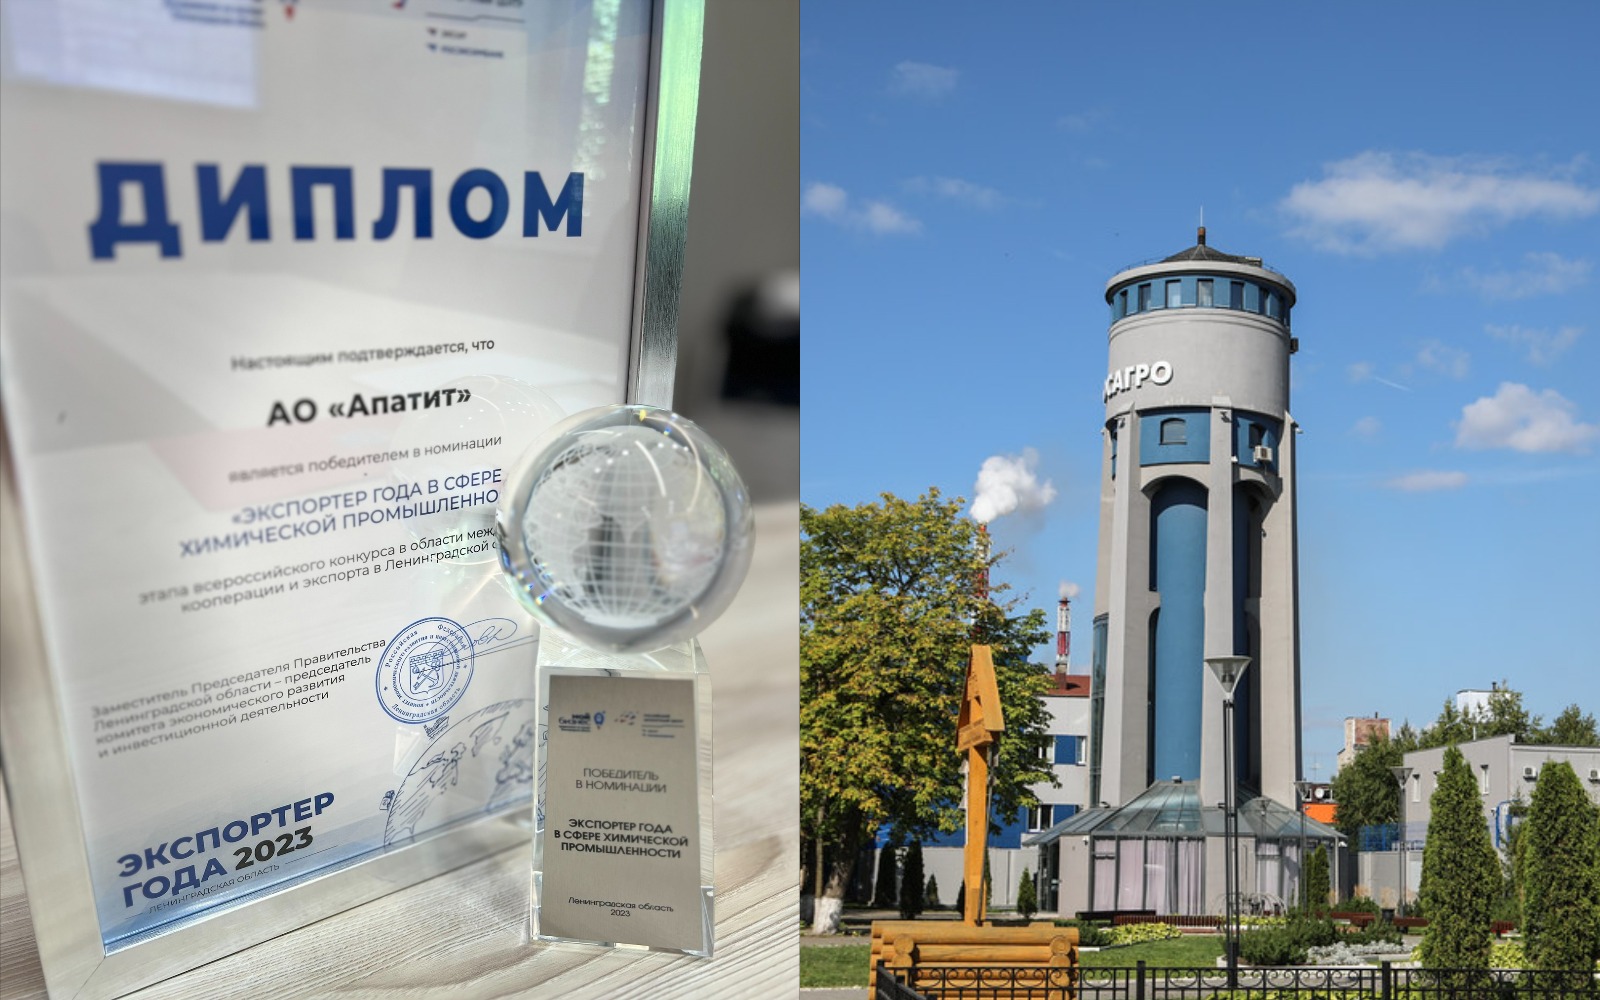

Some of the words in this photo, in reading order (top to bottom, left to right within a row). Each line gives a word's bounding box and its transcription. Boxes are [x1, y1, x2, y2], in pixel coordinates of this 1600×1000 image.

[88, 161, 585, 260] ДИПЛОМ
[231, 350, 333, 372] Настоящим
[338, 341, 469, 365] подтверждается,
[471, 338, 495, 352] что
[1103, 361, 1173, 402] САГРО
[266, 398, 318, 428] АО
[328, 386, 472, 420] «Апатит»
[228, 463, 303, 483] является
[308, 450, 409, 473] победителем
[413, 447, 421, 458] в
[424, 436, 502, 456] номинации
[231, 490, 368, 525] «ЭКСПОРТЕР
[372, 482, 423, 504] ГОДА
[428, 479, 439, 494] В
[444, 468, 502, 491] СФЕРЕ
[179, 513, 337, 558] ХИМИЧЕСКОЙ
[343, 489, 499, 531] ПРОМЫШЛЕННО
[139, 585, 190, 606] этапа
[194, 558, 326, 597] всероссийского
[329, 545, 395, 570] конкурса
[399, 543, 407, 555] в
[410, 531, 463, 552] области
[181, 584, 284, 614] кооперации
[288, 580, 299, 592] и
[302, 565, 370, 589] экспорта
[373, 563, 382, 574] в
[385, 540, 489, 572] Ленинградской
[385, 630, 418, 667] Российская
[91, 684, 188, 719] Заместитель
[191, 662, 290, 695] Председателя
[294, 638, 386, 669] Правительства
[94, 694, 212, 732] Ленинградской
[216, 679, 271, 701] области
[285, 655, 371, 684] председатель
[95, 720, 165, 746] комитета
[169, 689, 284, 727] экономического
[287, 674, 345, 696] развития
[98, 747, 110, 759] и
[112, 714, 237, 755] инвестиционной
[240, 691, 330, 723] деятельности
[576, 780, 583, 789] В
[585, 780, 667, 793] НОМИНАЦИИ
[583, 767, 659, 781] ПОБЕДИТЕЛЬ
[117, 792, 335, 878] ЭКСПОРТЕР
[554, 830, 561, 839] В
[563, 830, 601, 841] СФЕРЕ
[603, 833, 688, 847] ХИМИЧЕСКОЙ
[561, 842, 681, 858] ПРОМЫШЛЕННОСТИ
[568, 818, 636, 831] ЭКСПОРТЕР
[639, 823, 673, 834] ГОДА
[122, 857, 228, 908] ГОДА
[233, 826, 314, 871] 2023
[149, 878, 235, 914] ЛЕНИНГРАДСКАЯ
[236, 864, 281, 883] ОБЛАСТЬ
[568, 897, 636, 909] Ленинградская
[638, 903, 674, 913] область
[610, 909, 631, 917] 2023
